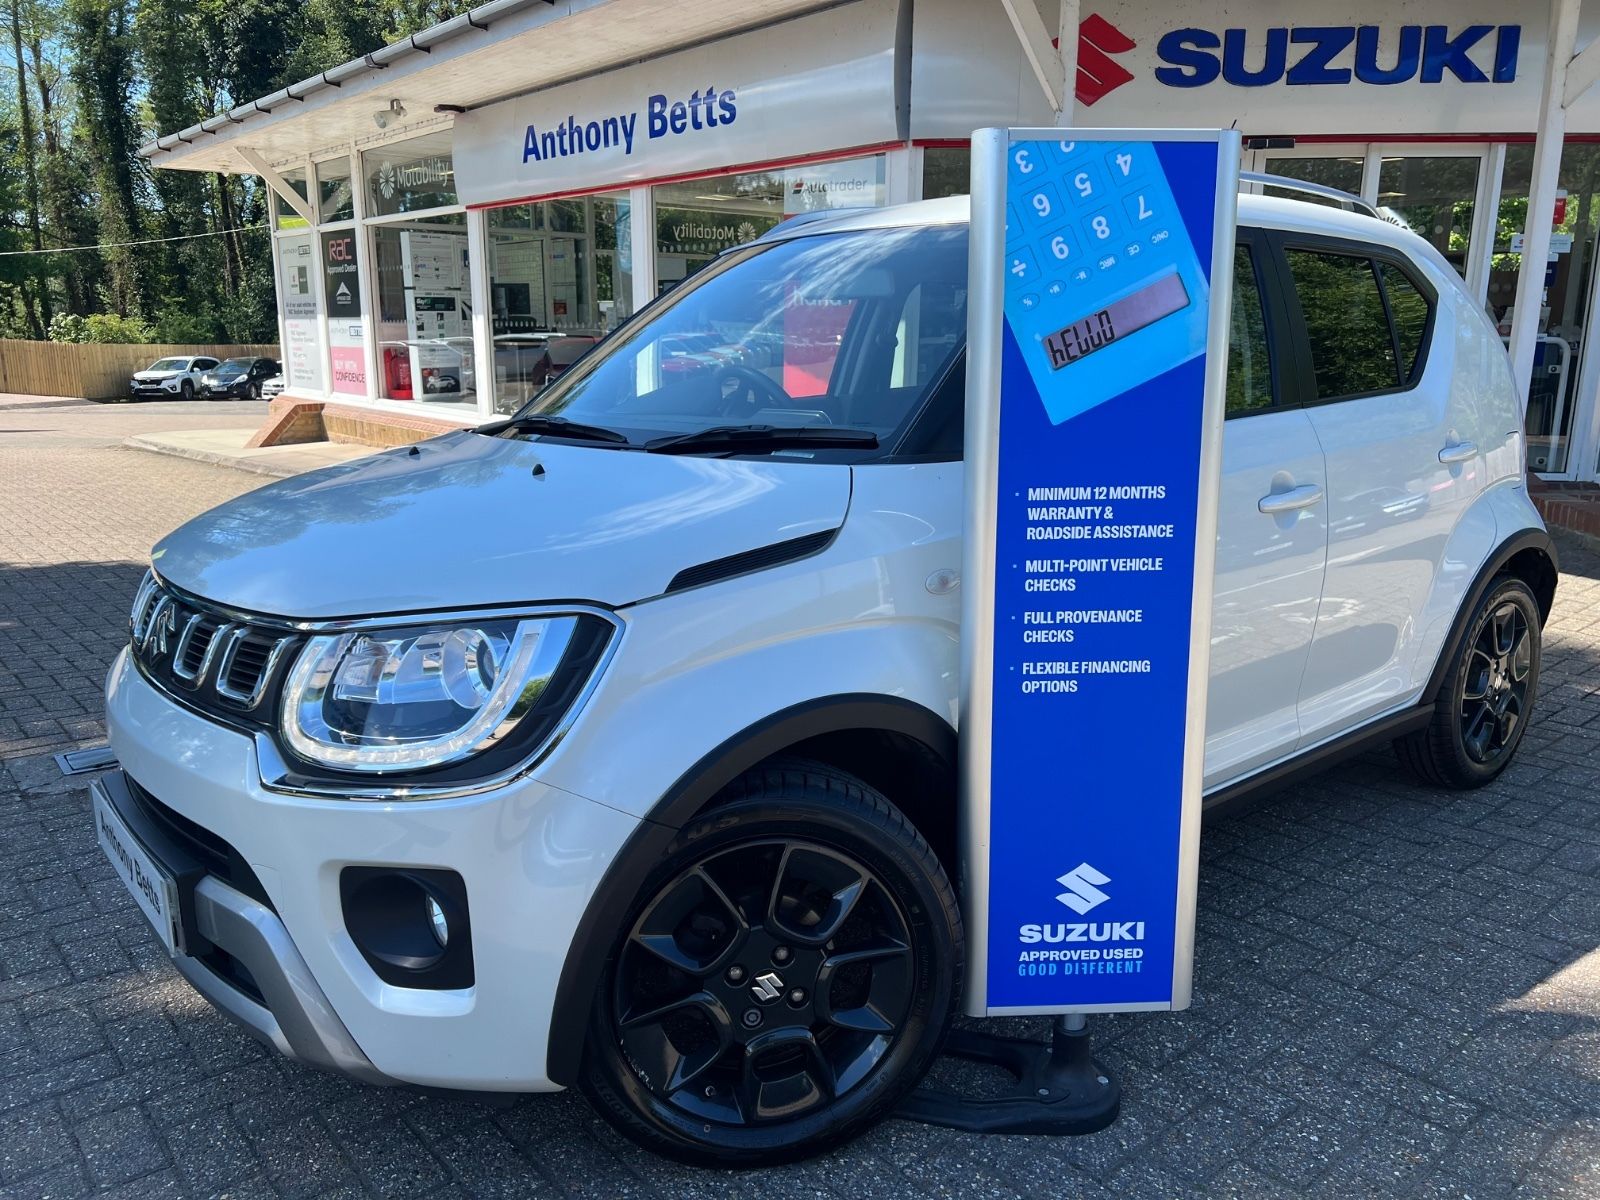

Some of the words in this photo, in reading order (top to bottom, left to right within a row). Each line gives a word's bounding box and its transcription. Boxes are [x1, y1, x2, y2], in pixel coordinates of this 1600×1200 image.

[1155, 25, 1522, 88] SUZUKI
[522, 112, 637, 163] Anthony
[648, 86, 737, 139] Betts
[1015, 150, 1034, 174] 3
[1115, 153, 1132, 176] 4
[396, 158, 449, 188] Motability
[1074, 172, 1093, 197] 5
[1138, 195, 1153, 220] 7
[1091, 215, 1110, 239] 8
[335, 371, 366, 384] CONFIDENCE
[1028, 487, 1091, 501] MINIMUM
[1093, 487, 1107, 500] 12
[1109, 486, 1166, 500] MONTHS
[1028, 506, 1102, 520] WARRANTY
[1104, 506, 1114, 519] &
[1027, 526, 1091, 540] ROADSIDE
[1093, 525, 1174, 539] ASSISTANCE
[1025, 559, 1108, 573] MULTI-POINT
[1110, 558, 1163, 571] VEHICLE
[1025, 578, 1076, 592] CHECKS
[1024, 611, 1054, 624] FULL
[1056, 610, 1143, 623] PROVENANCE
[1023, 630, 1074, 643] CHECKS
[1022, 662, 1079, 675] FLEXIBLE
[1081, 660, 1151, 674] FINANCING
[1022, 680, 1078, 693] OPTIONS
[101, 810, 134, 882] Anthony
[134, 858, 161, 915] Betts
[1019, 922, 1145, 943] SUZUKI
[1019, 950, 1100, 962] APPROVED
[1103, 948, 1143, 960] USED
[1018, 963, 1057, 976] GOOD
[1064, 961, 1143, 975] DIFFERENT
